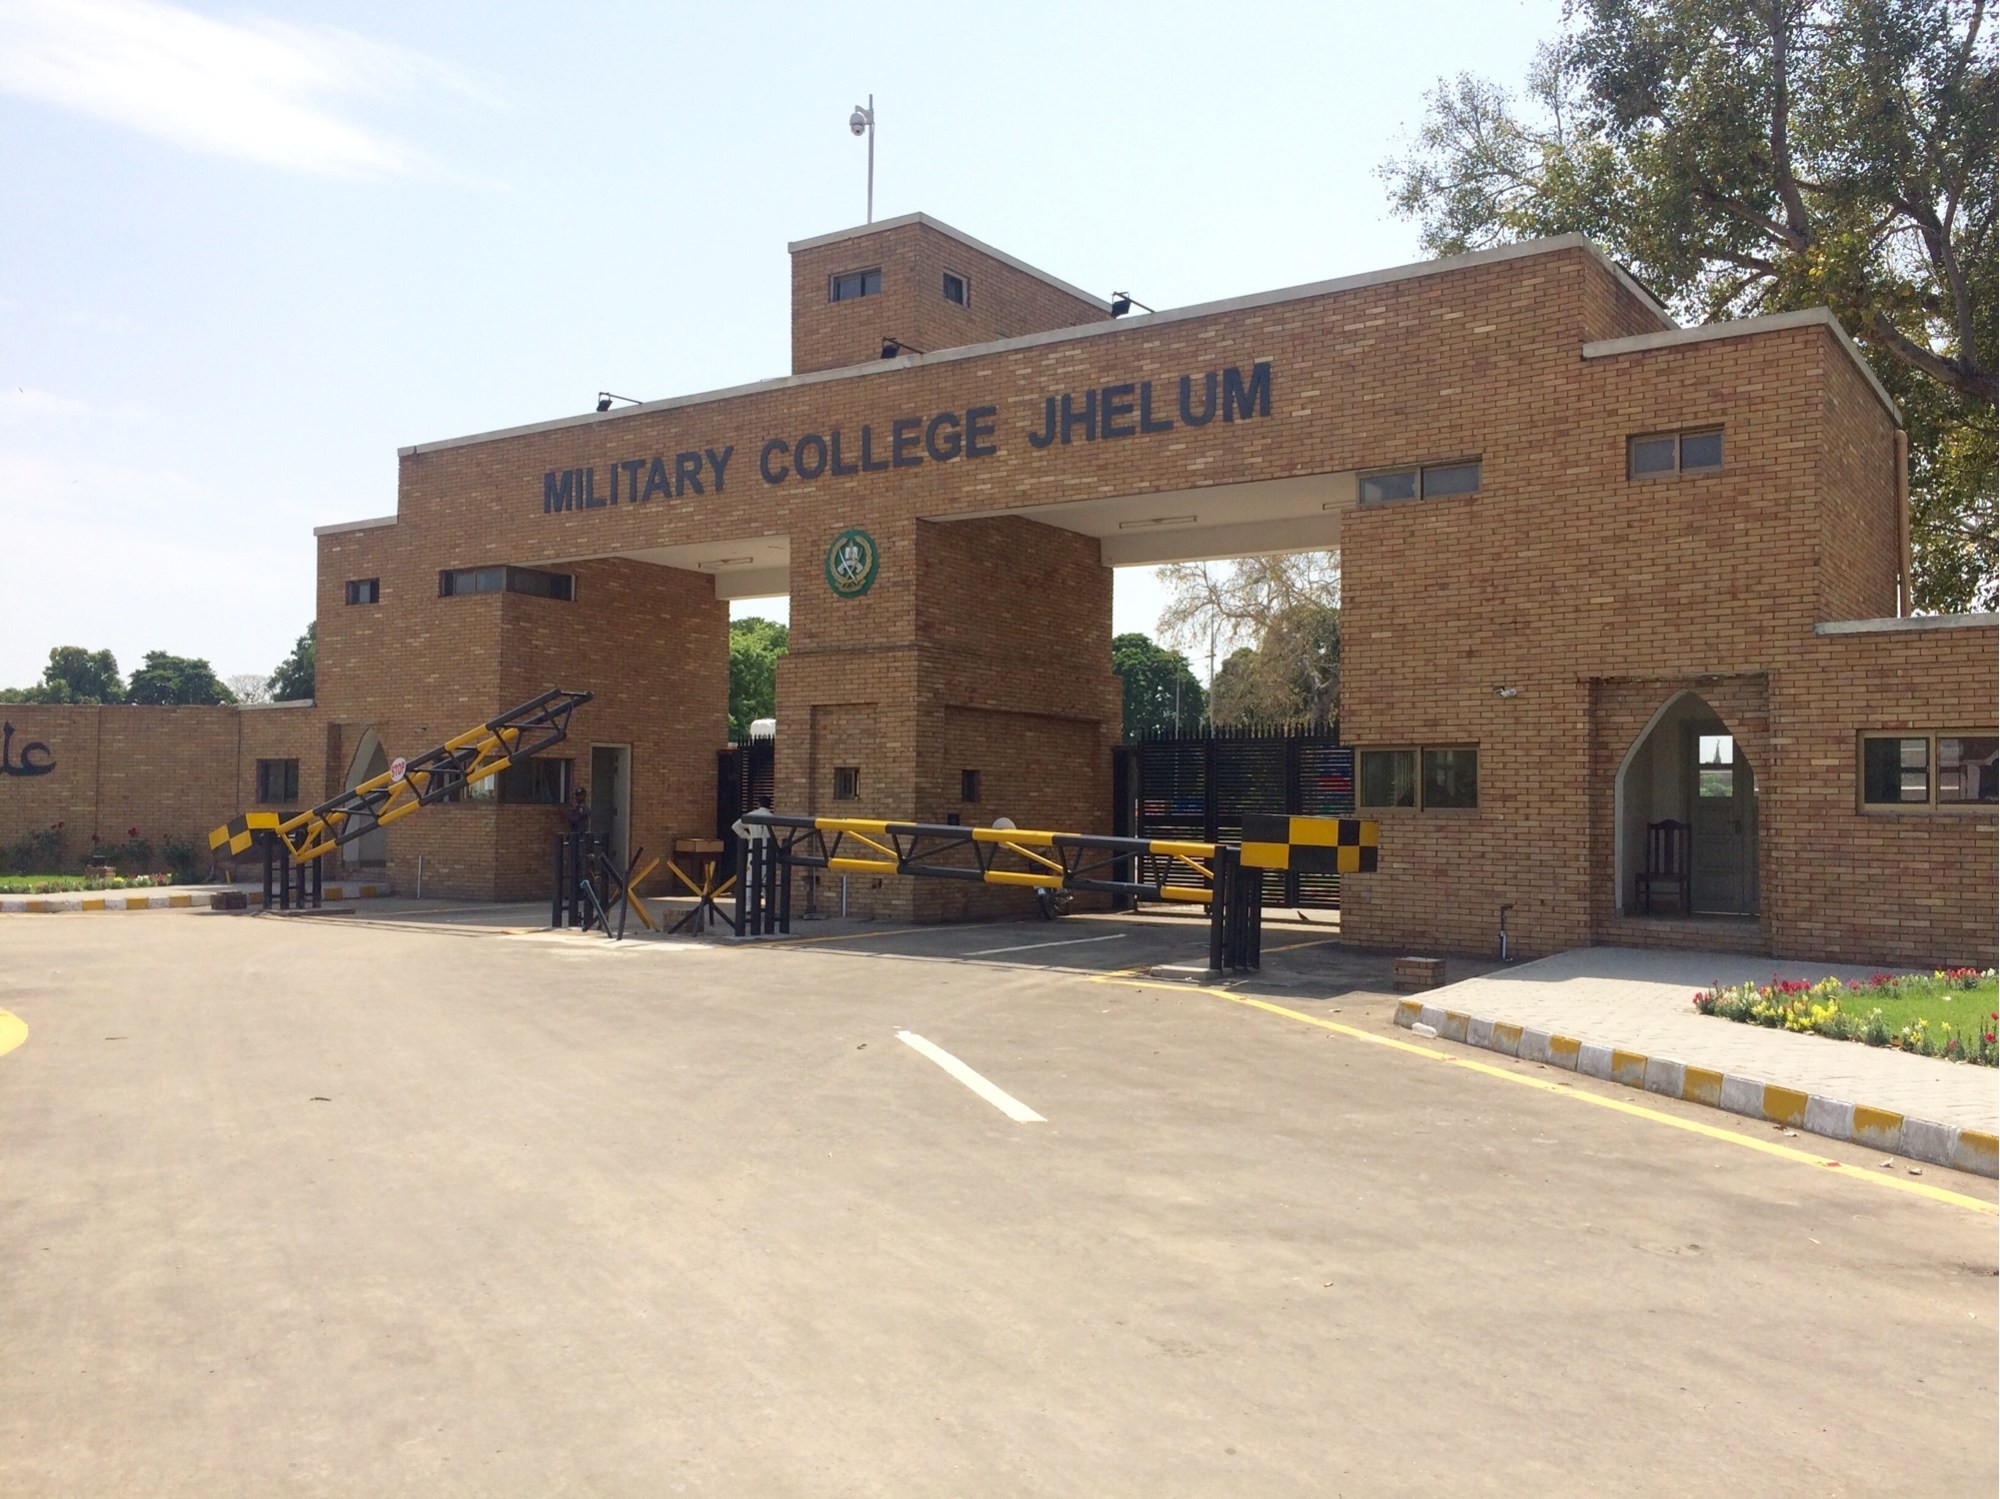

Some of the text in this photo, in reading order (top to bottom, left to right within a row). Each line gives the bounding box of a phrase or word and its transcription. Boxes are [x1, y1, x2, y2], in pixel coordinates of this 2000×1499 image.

[544, 362, 1272, 513] MILITARY COLLEGE JHELUM
[391, 761, 405, 778] STOP
